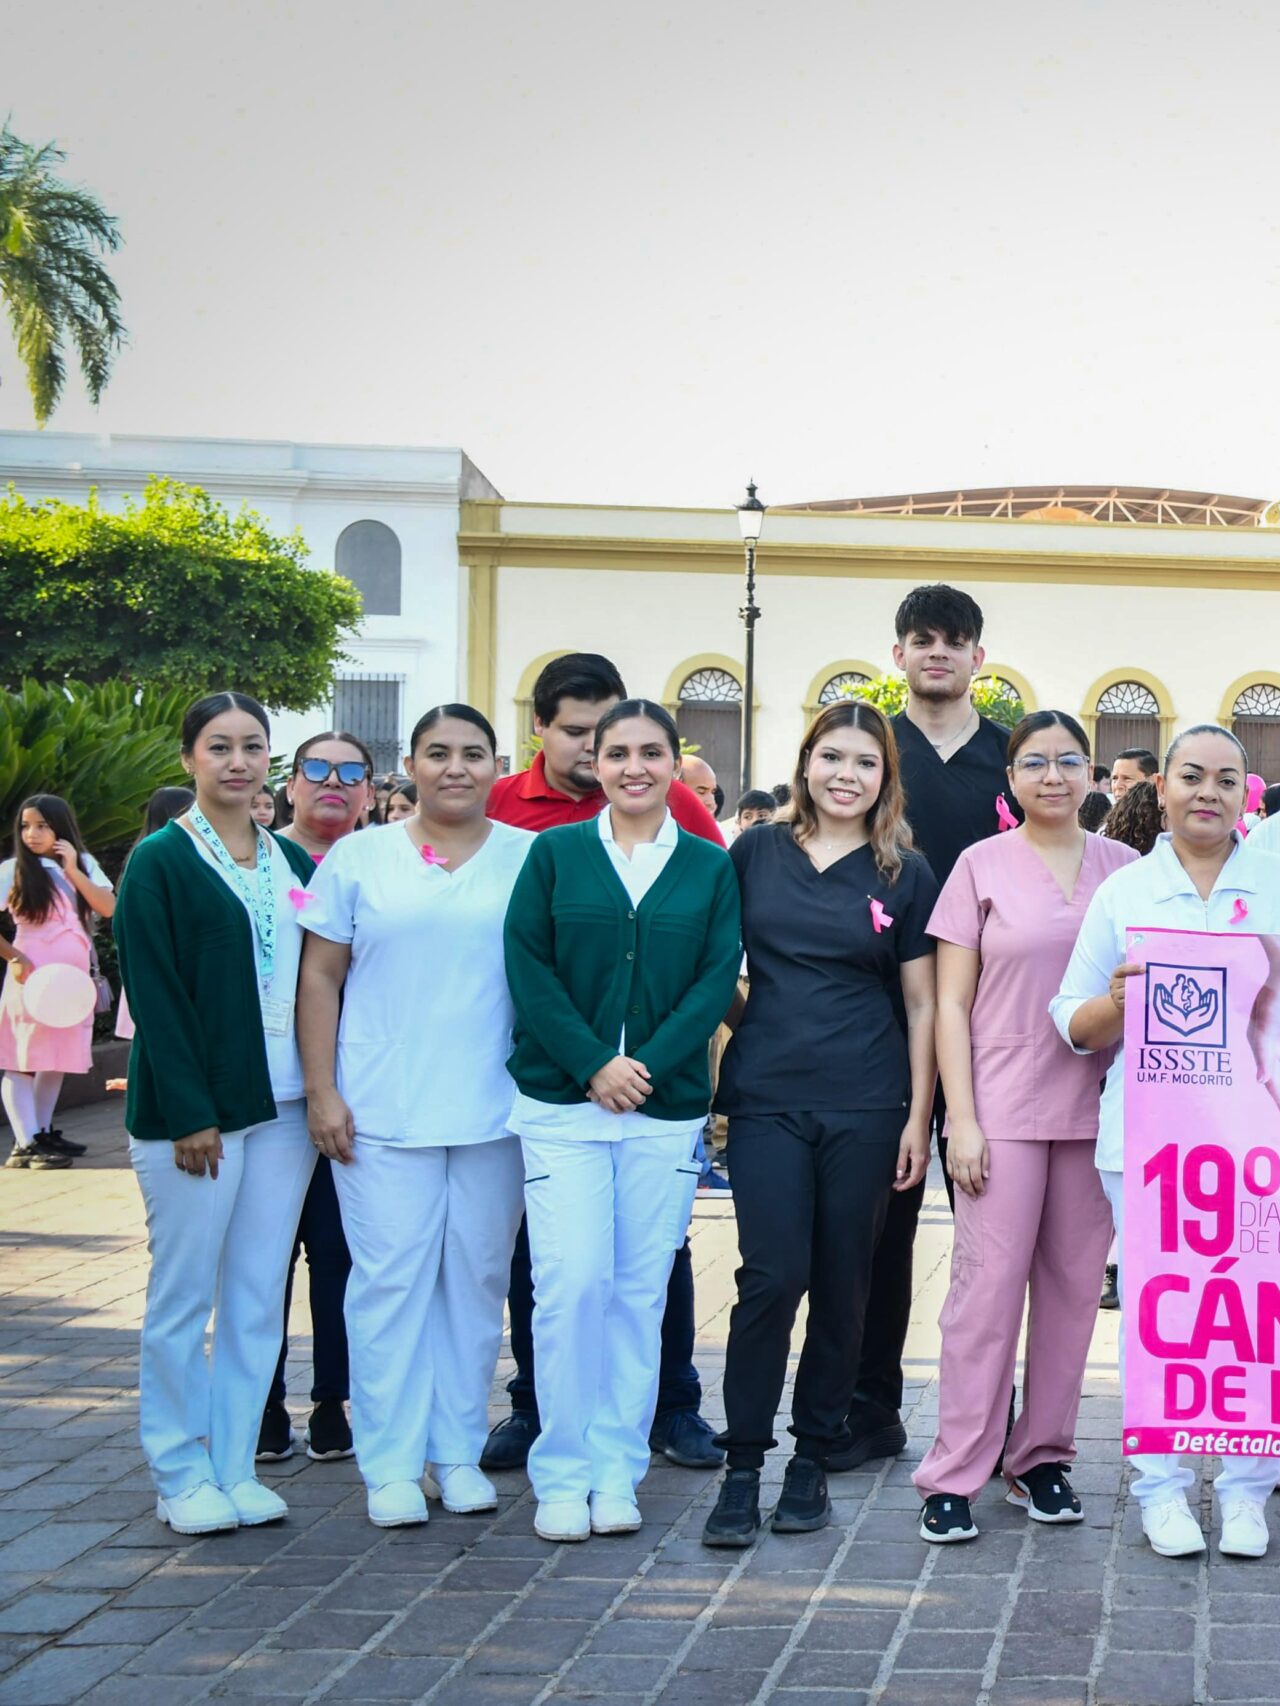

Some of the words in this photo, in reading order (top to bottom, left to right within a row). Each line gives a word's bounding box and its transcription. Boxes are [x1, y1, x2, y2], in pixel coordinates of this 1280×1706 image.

[1138, 1048, 1232, 1073] ISSSTE
[1137, 1072, 1170, 1084] U.M.F.
[1172, 1074, 1233, 1086] MOCORITO
[1143, 1143, 1236, 1257] 19
[1239, 1230, 1270, 1254] DE
[1164, 1363, 1247, 1423] DE
